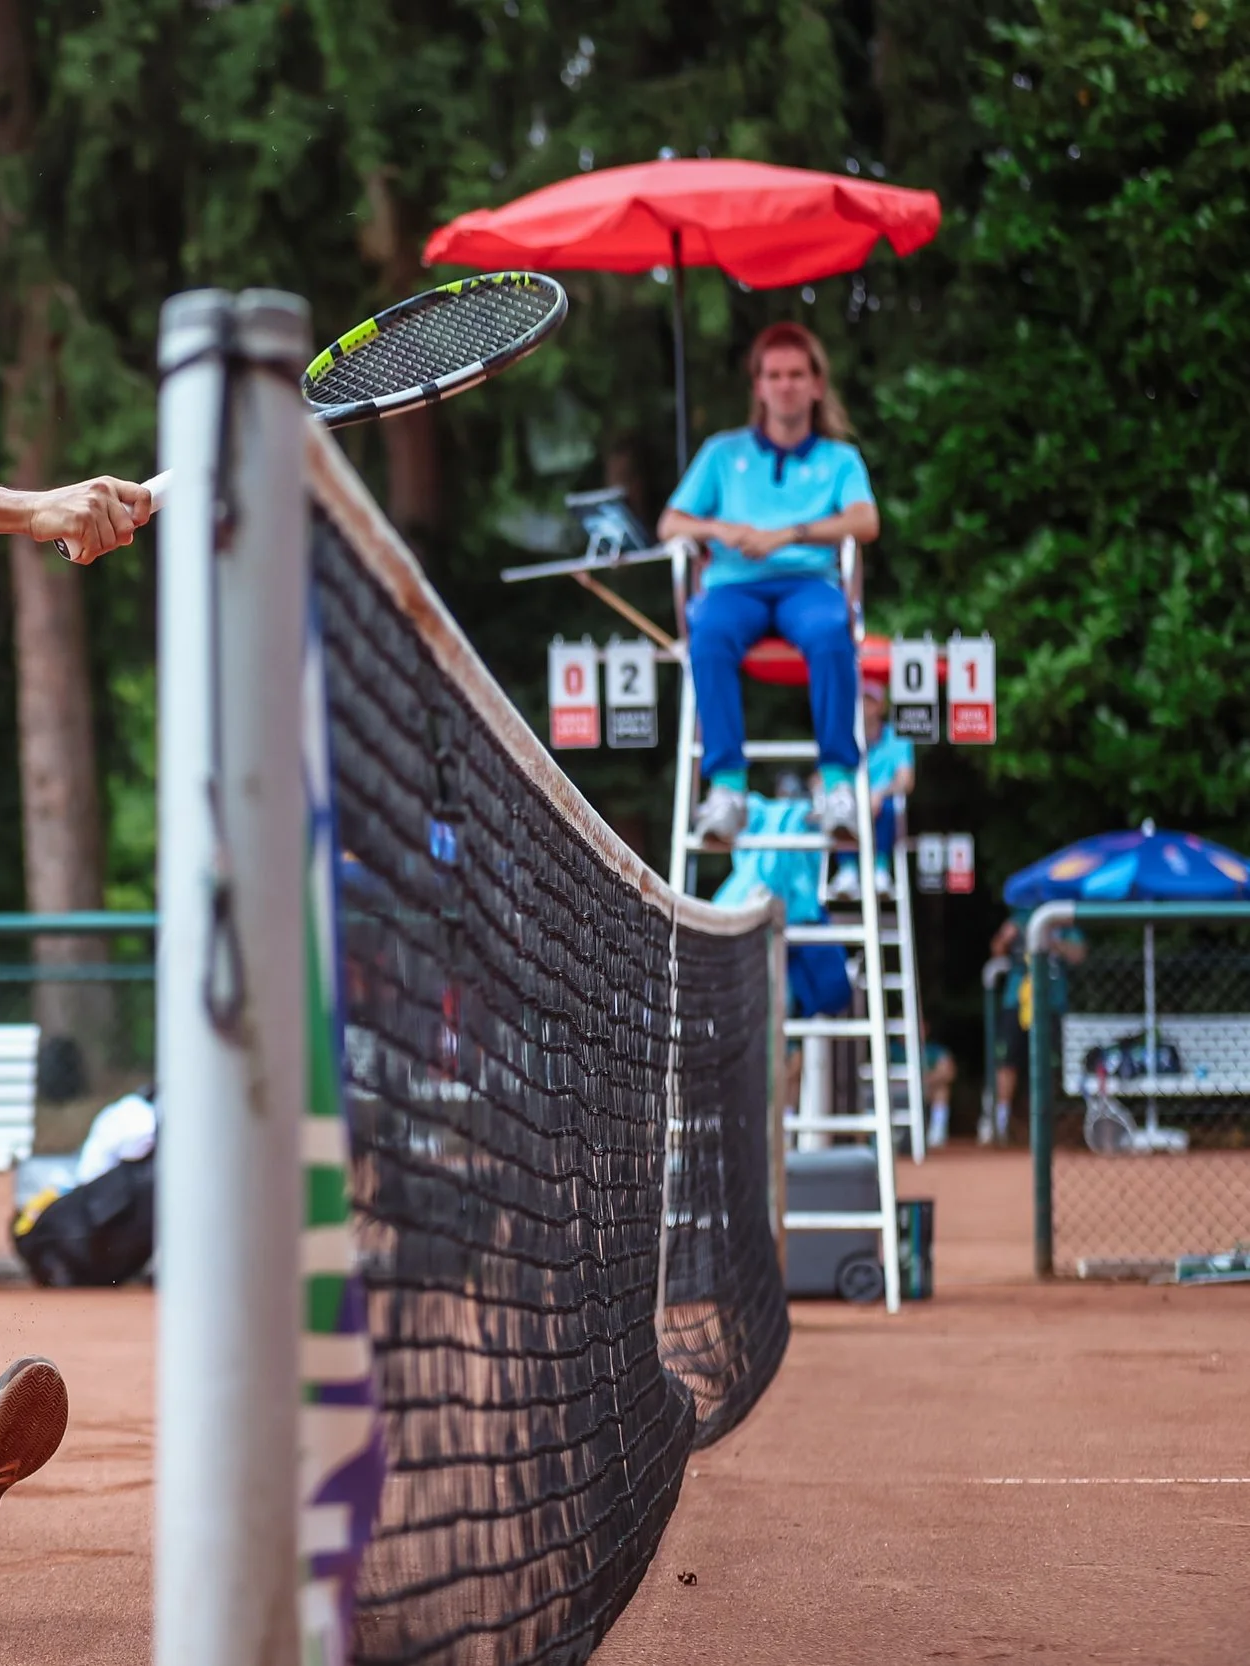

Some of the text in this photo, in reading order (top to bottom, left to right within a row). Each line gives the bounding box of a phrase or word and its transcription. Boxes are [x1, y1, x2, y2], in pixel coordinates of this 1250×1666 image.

[564, 661, 639, 697] 0 2
[904, 659, 977, 692] 0 1
